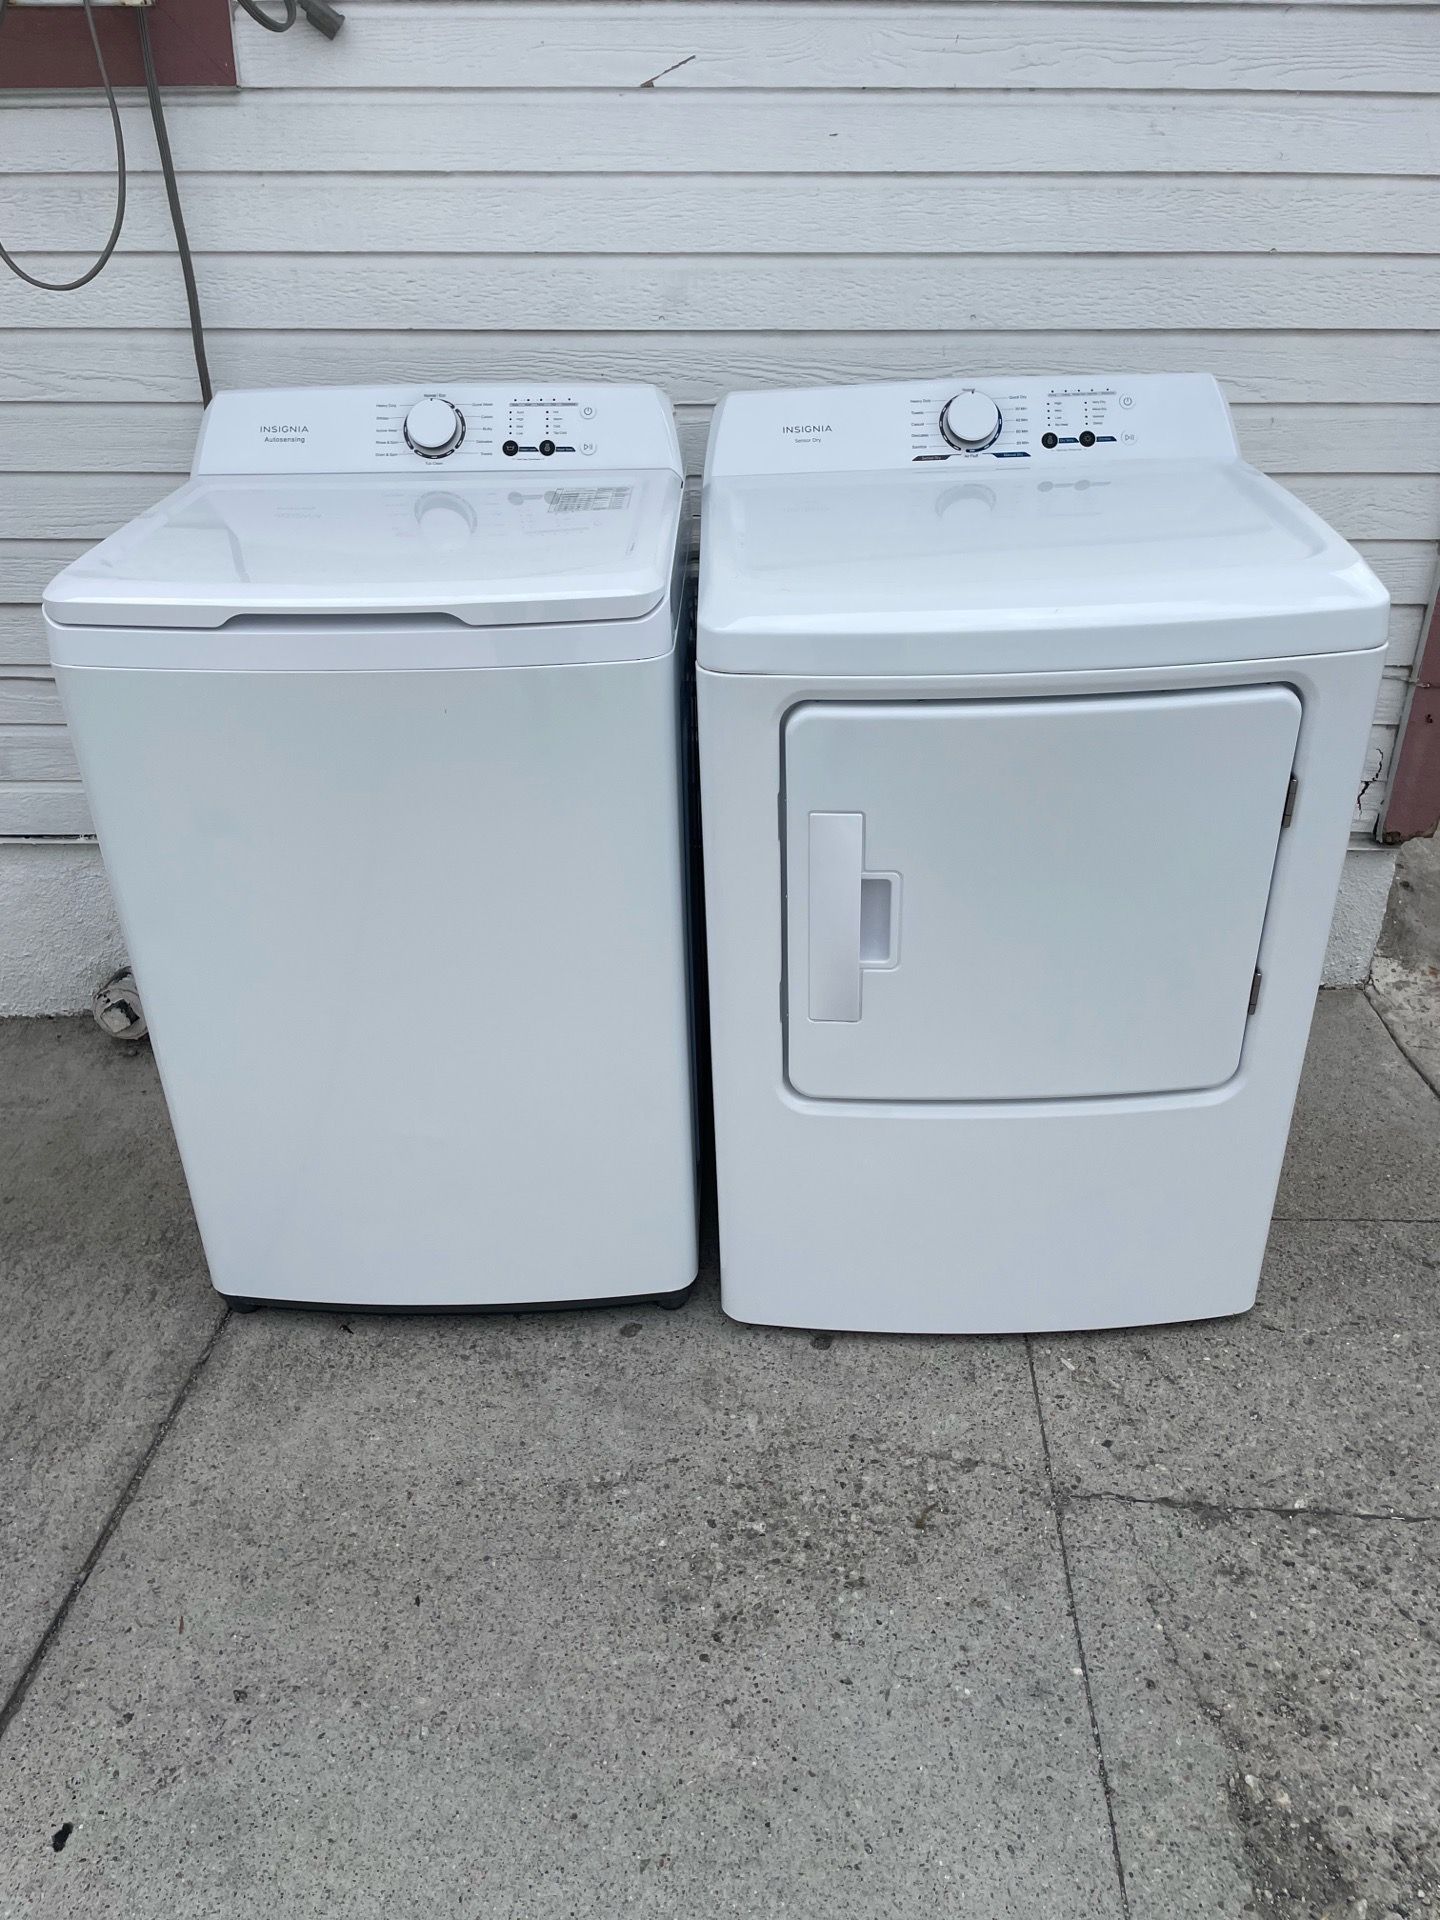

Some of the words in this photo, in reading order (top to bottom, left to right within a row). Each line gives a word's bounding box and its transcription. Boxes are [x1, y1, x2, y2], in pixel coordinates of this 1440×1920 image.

[260, 425, 309, 433] INSIGNIA
[782, 424, 833, 434] INSIGNIA
[264, 436, 306, 444] Autosensing
